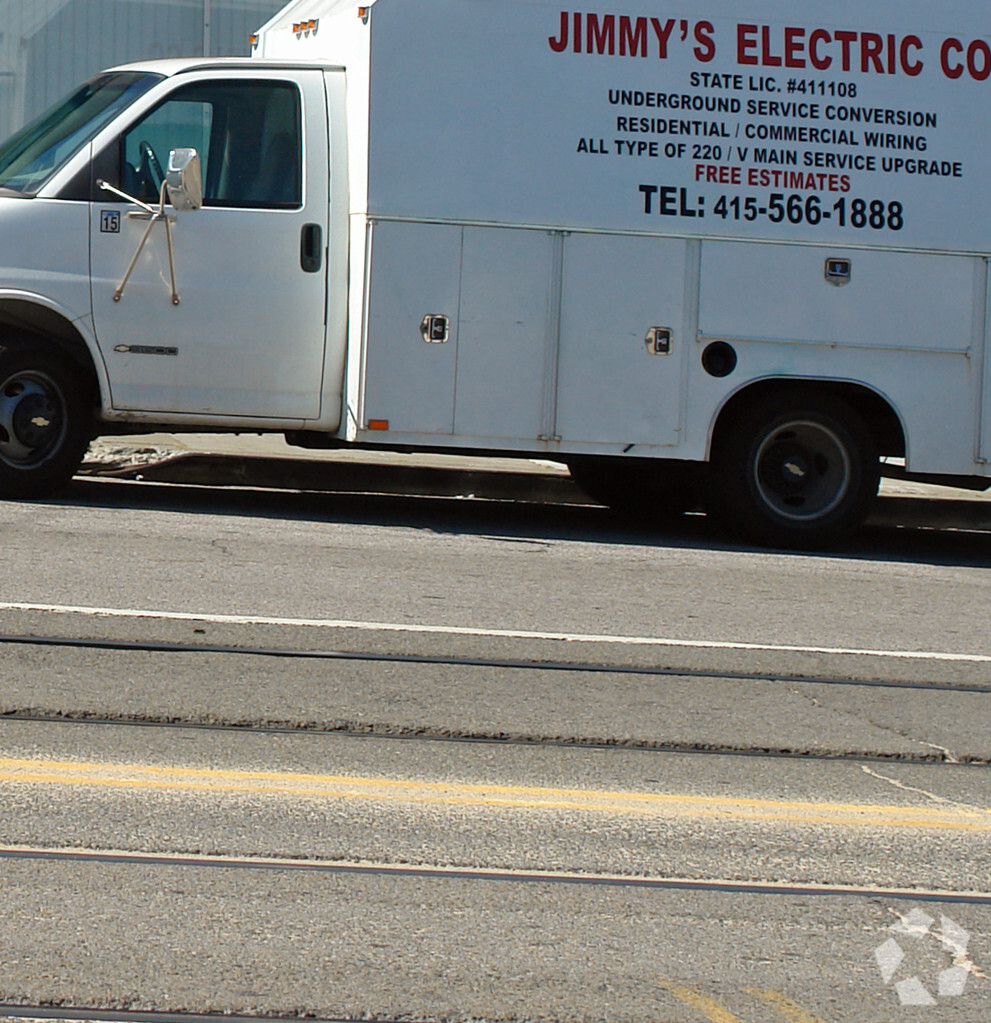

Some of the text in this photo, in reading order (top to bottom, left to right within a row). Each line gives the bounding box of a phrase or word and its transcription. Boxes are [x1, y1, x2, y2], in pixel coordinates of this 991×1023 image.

[548, 11, 715, 63] JIMMY'S
[737, 23, 923, 76] ELECTRIC
[690, 71, 857, 98] STATE LIC. #411108
[608, 89, 937, 128] UNDERGROUND SERVICE CONVERSION
[617, 116, 730, 138] RESIDENTIAL
[745, 124, 859, 146] COMMERCIAL
[864, 131, 927, 151] WIRING
[577, 138, 609, 154] ALL
[614, 140, 658, 157] TYPE
[664, 143, 687, 158] OF
[692, 144, 721, 161] 220
[737, 147, 748, 162] V
[754, 148, 797, 165] MAIN
[803, 151, 876, 171] SERVICE
[882, 157, 962, 177] UPGRADE
[695, 164, 851, 192] FREE ESTIMATES
[104, 215, 118, 231] 15
[639, 184, 904, 231] TEL: 415-566-1888
